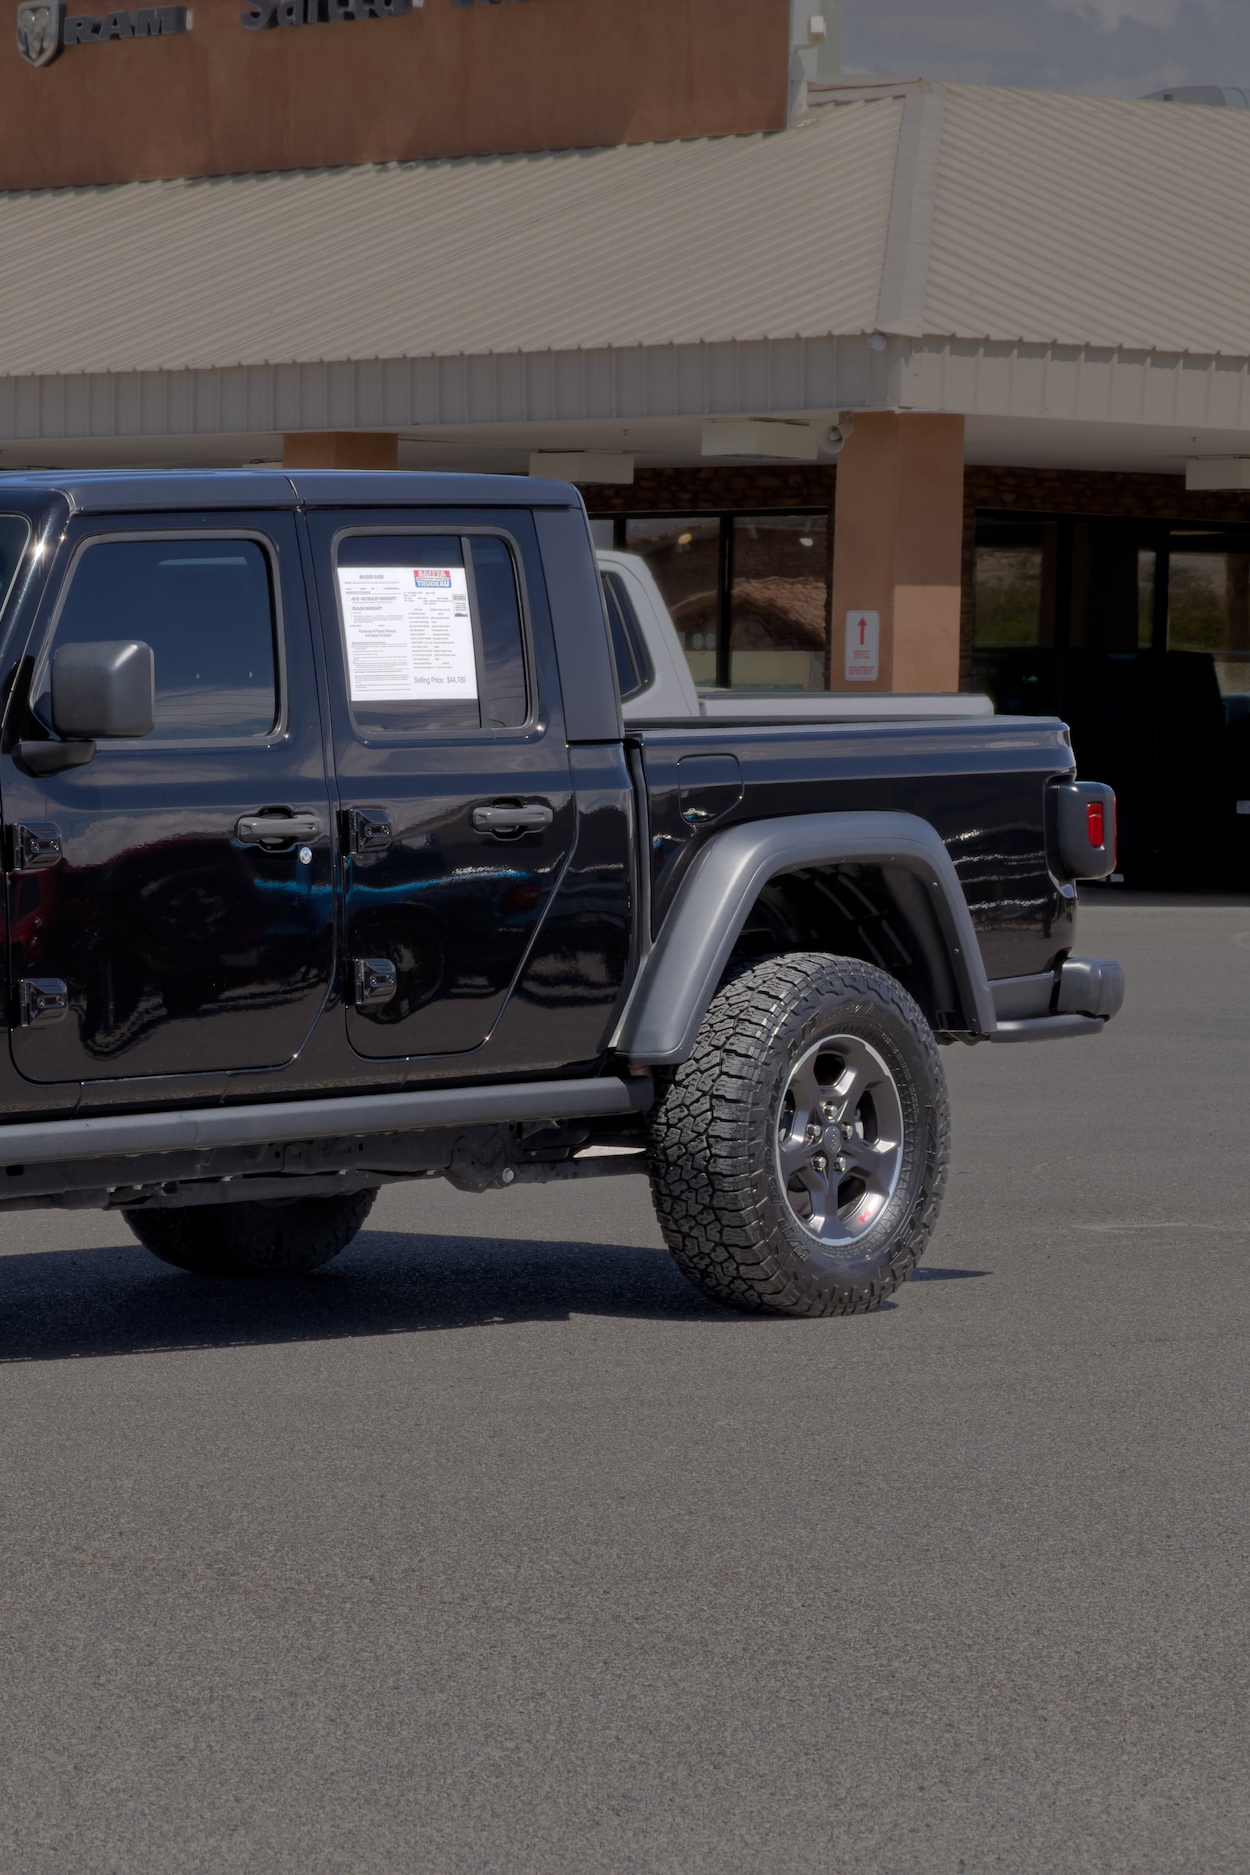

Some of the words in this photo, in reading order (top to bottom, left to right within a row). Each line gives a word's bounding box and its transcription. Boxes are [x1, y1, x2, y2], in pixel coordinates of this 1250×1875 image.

[64, 5, 180, 45] RAM
[417, 579, 449, 587] TRUDEAU
[853, 650, 870, 659] SERVICE
[414, 676, 430, 685] Selling
